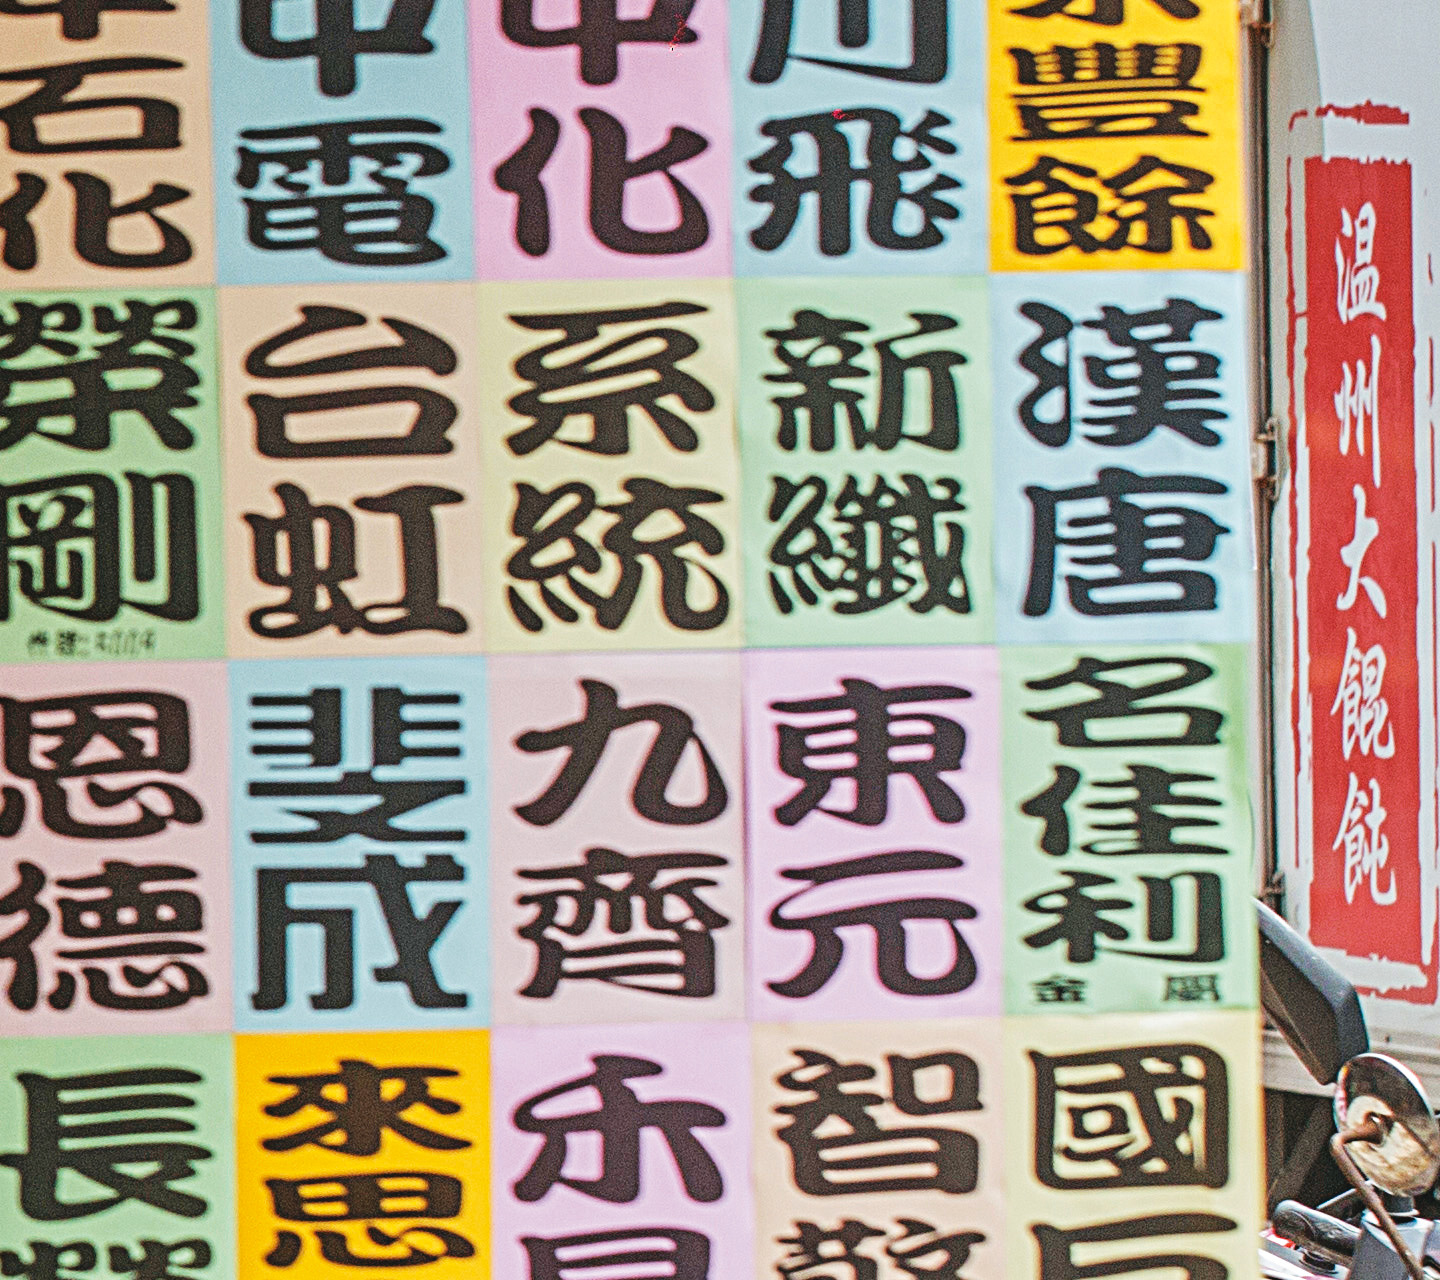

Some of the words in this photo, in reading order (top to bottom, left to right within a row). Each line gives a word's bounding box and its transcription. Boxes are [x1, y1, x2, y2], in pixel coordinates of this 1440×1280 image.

[244, 306, 468, 638] 台虹
[507, 302, 729, 632] 系統
[764, 310, 971, 614] 新纖
[1019, 299, 1229, 616] 漢唐
[515, 680, 729, 998] 九齊
[768, 679, 977, 997] 東元
[1022, 657, 1228, 962] 名佳利
